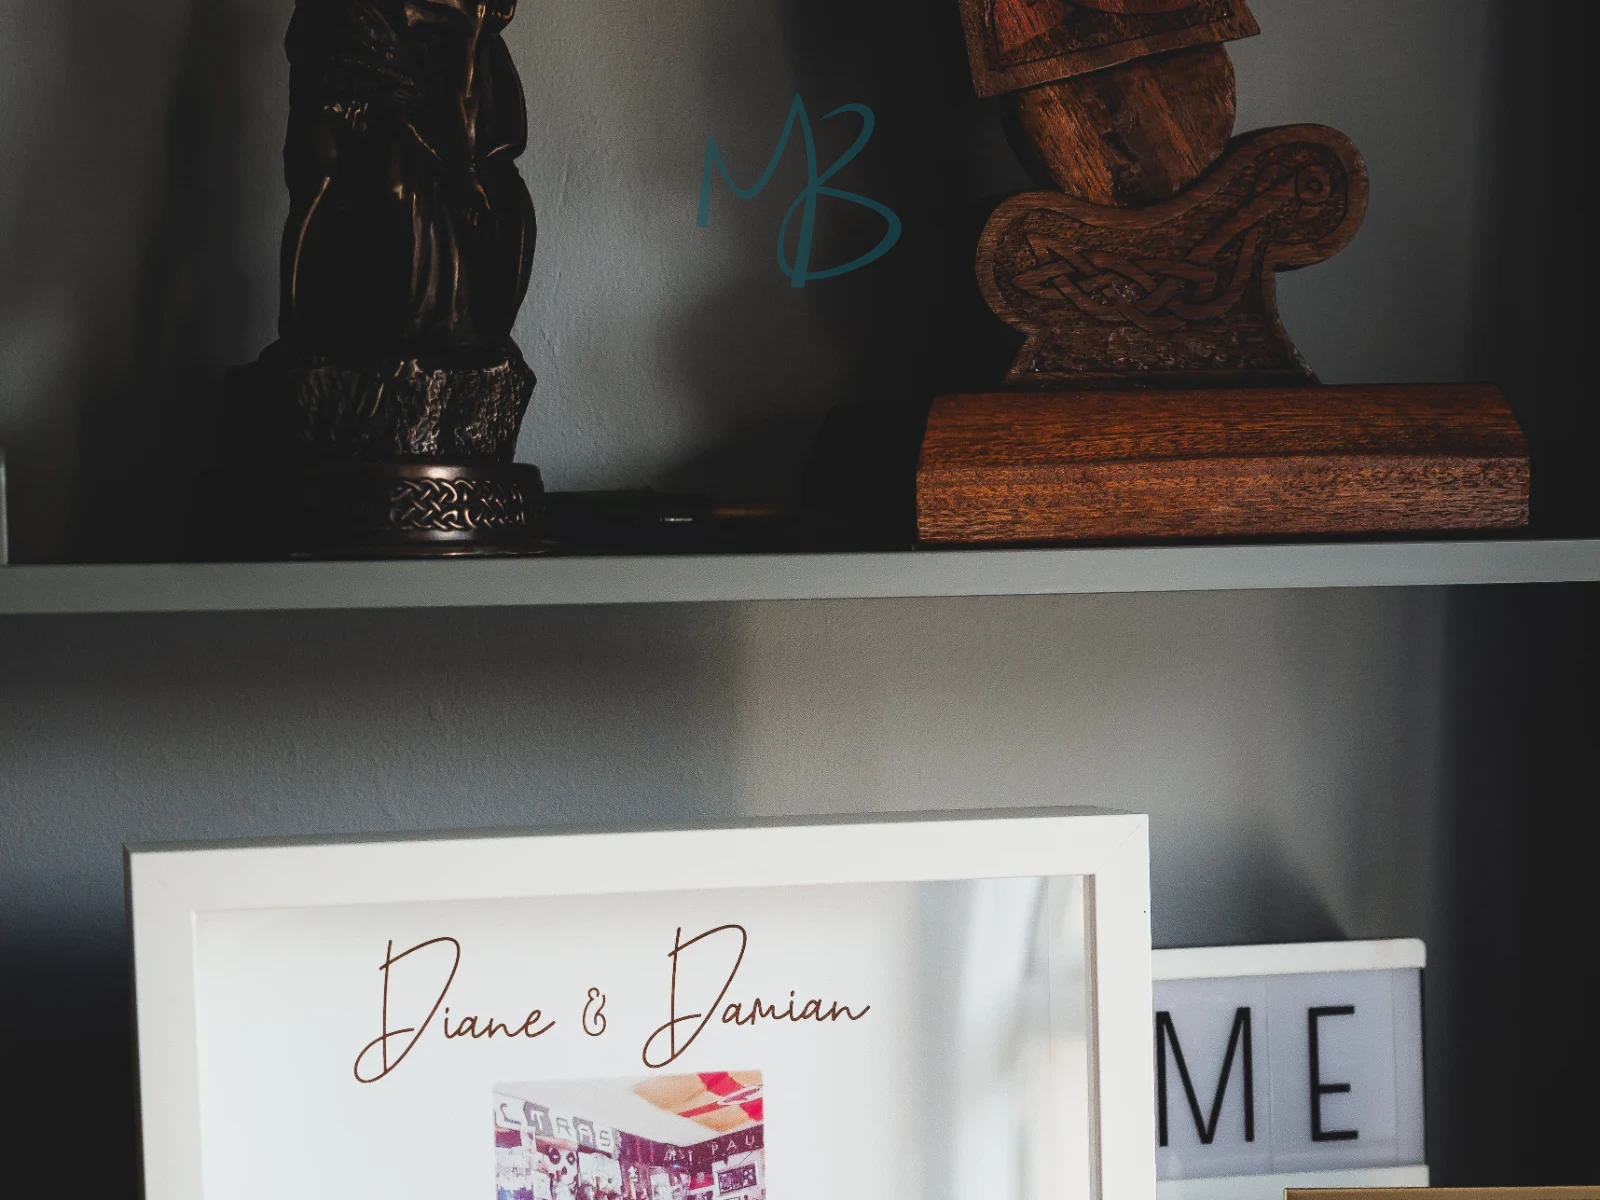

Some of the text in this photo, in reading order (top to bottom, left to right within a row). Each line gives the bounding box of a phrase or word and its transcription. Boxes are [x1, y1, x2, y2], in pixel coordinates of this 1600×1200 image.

[353, 924, 871, 1083] Diane & Damian
